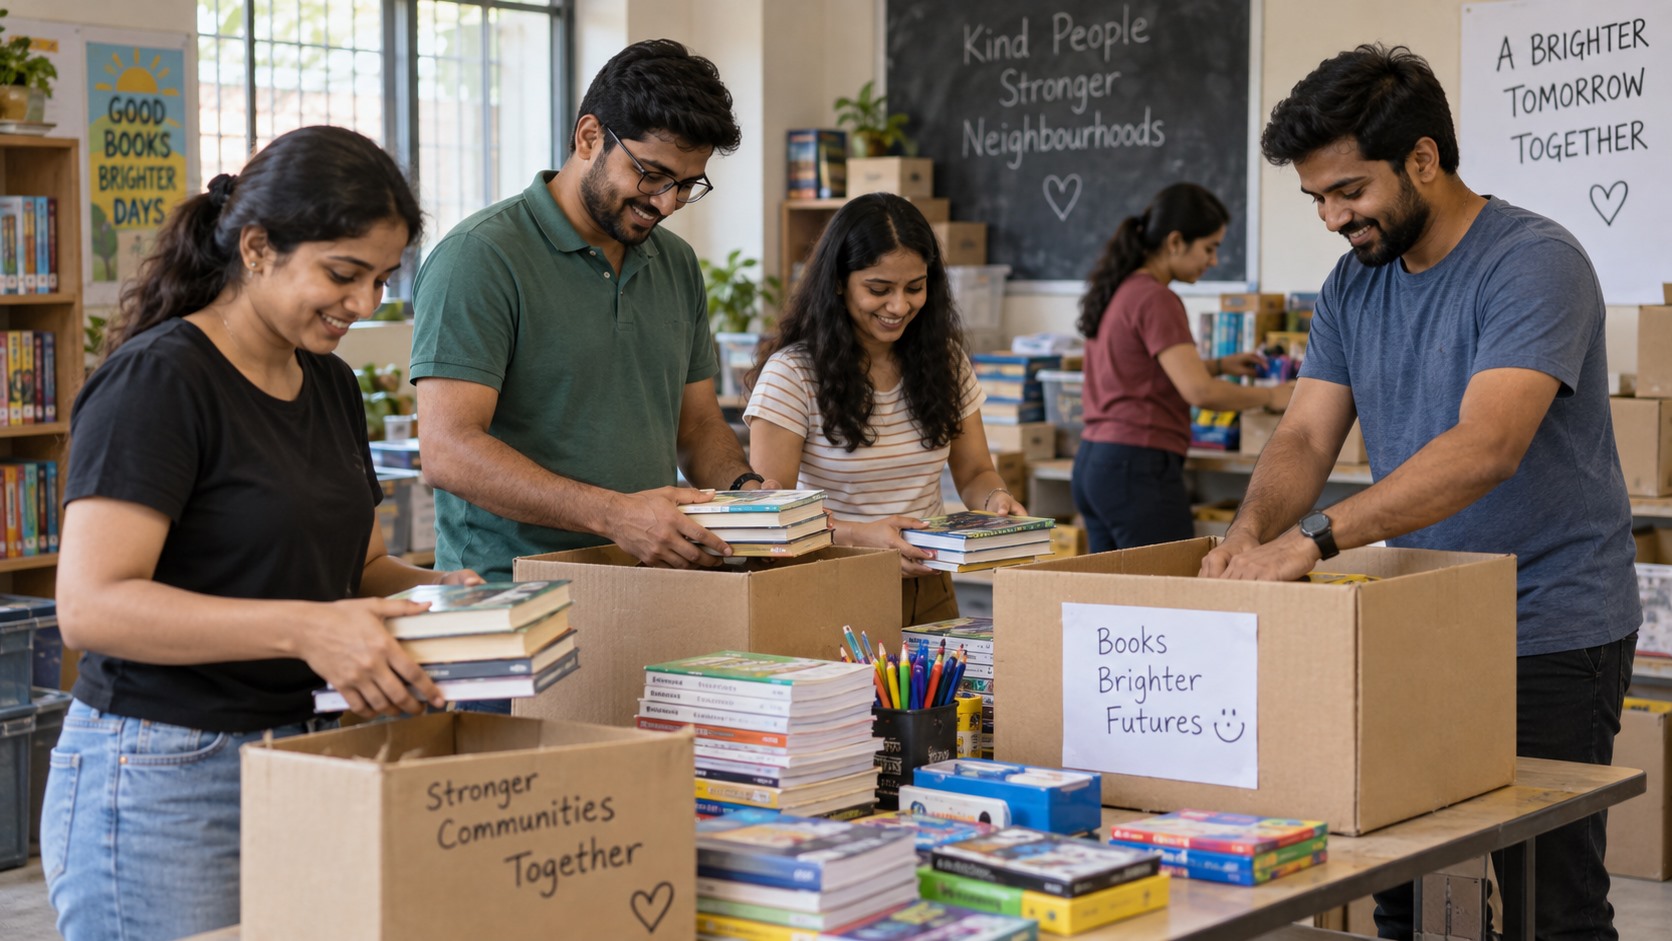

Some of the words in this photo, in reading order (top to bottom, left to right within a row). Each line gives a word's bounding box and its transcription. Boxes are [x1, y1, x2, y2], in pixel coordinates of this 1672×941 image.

[962, 16, 1030, 65] Kind
[1052, 4, 1151, 62] People
[1496, 35, 1515, 72] A
[1530, 18, 1650, 66] BRIGHTER
[108, 96, 166, 126] GOOD
[999, 68, 1122, 115] Stronger
[1503, 67, 1645, 118] TOMORROW
[104, 130, 171, 159] BOOKS
[961, 105, 1166, 170] Neighbourhoods
[1510, 120, 1649, 165] TOGETHER
[98, 165, 177, 192] BRIGHTER
[113, 197, 165, 226] DAYS
[1096, 625, 1168, 656] Books
[1098, 665, 1203, 704] Brighter
[1106, 706, 1204, 736] Futures
[425, 772, 539, 812] Stronger
[437, 796, 616, 850] Communities
[503, 836, 643, 899] Together
